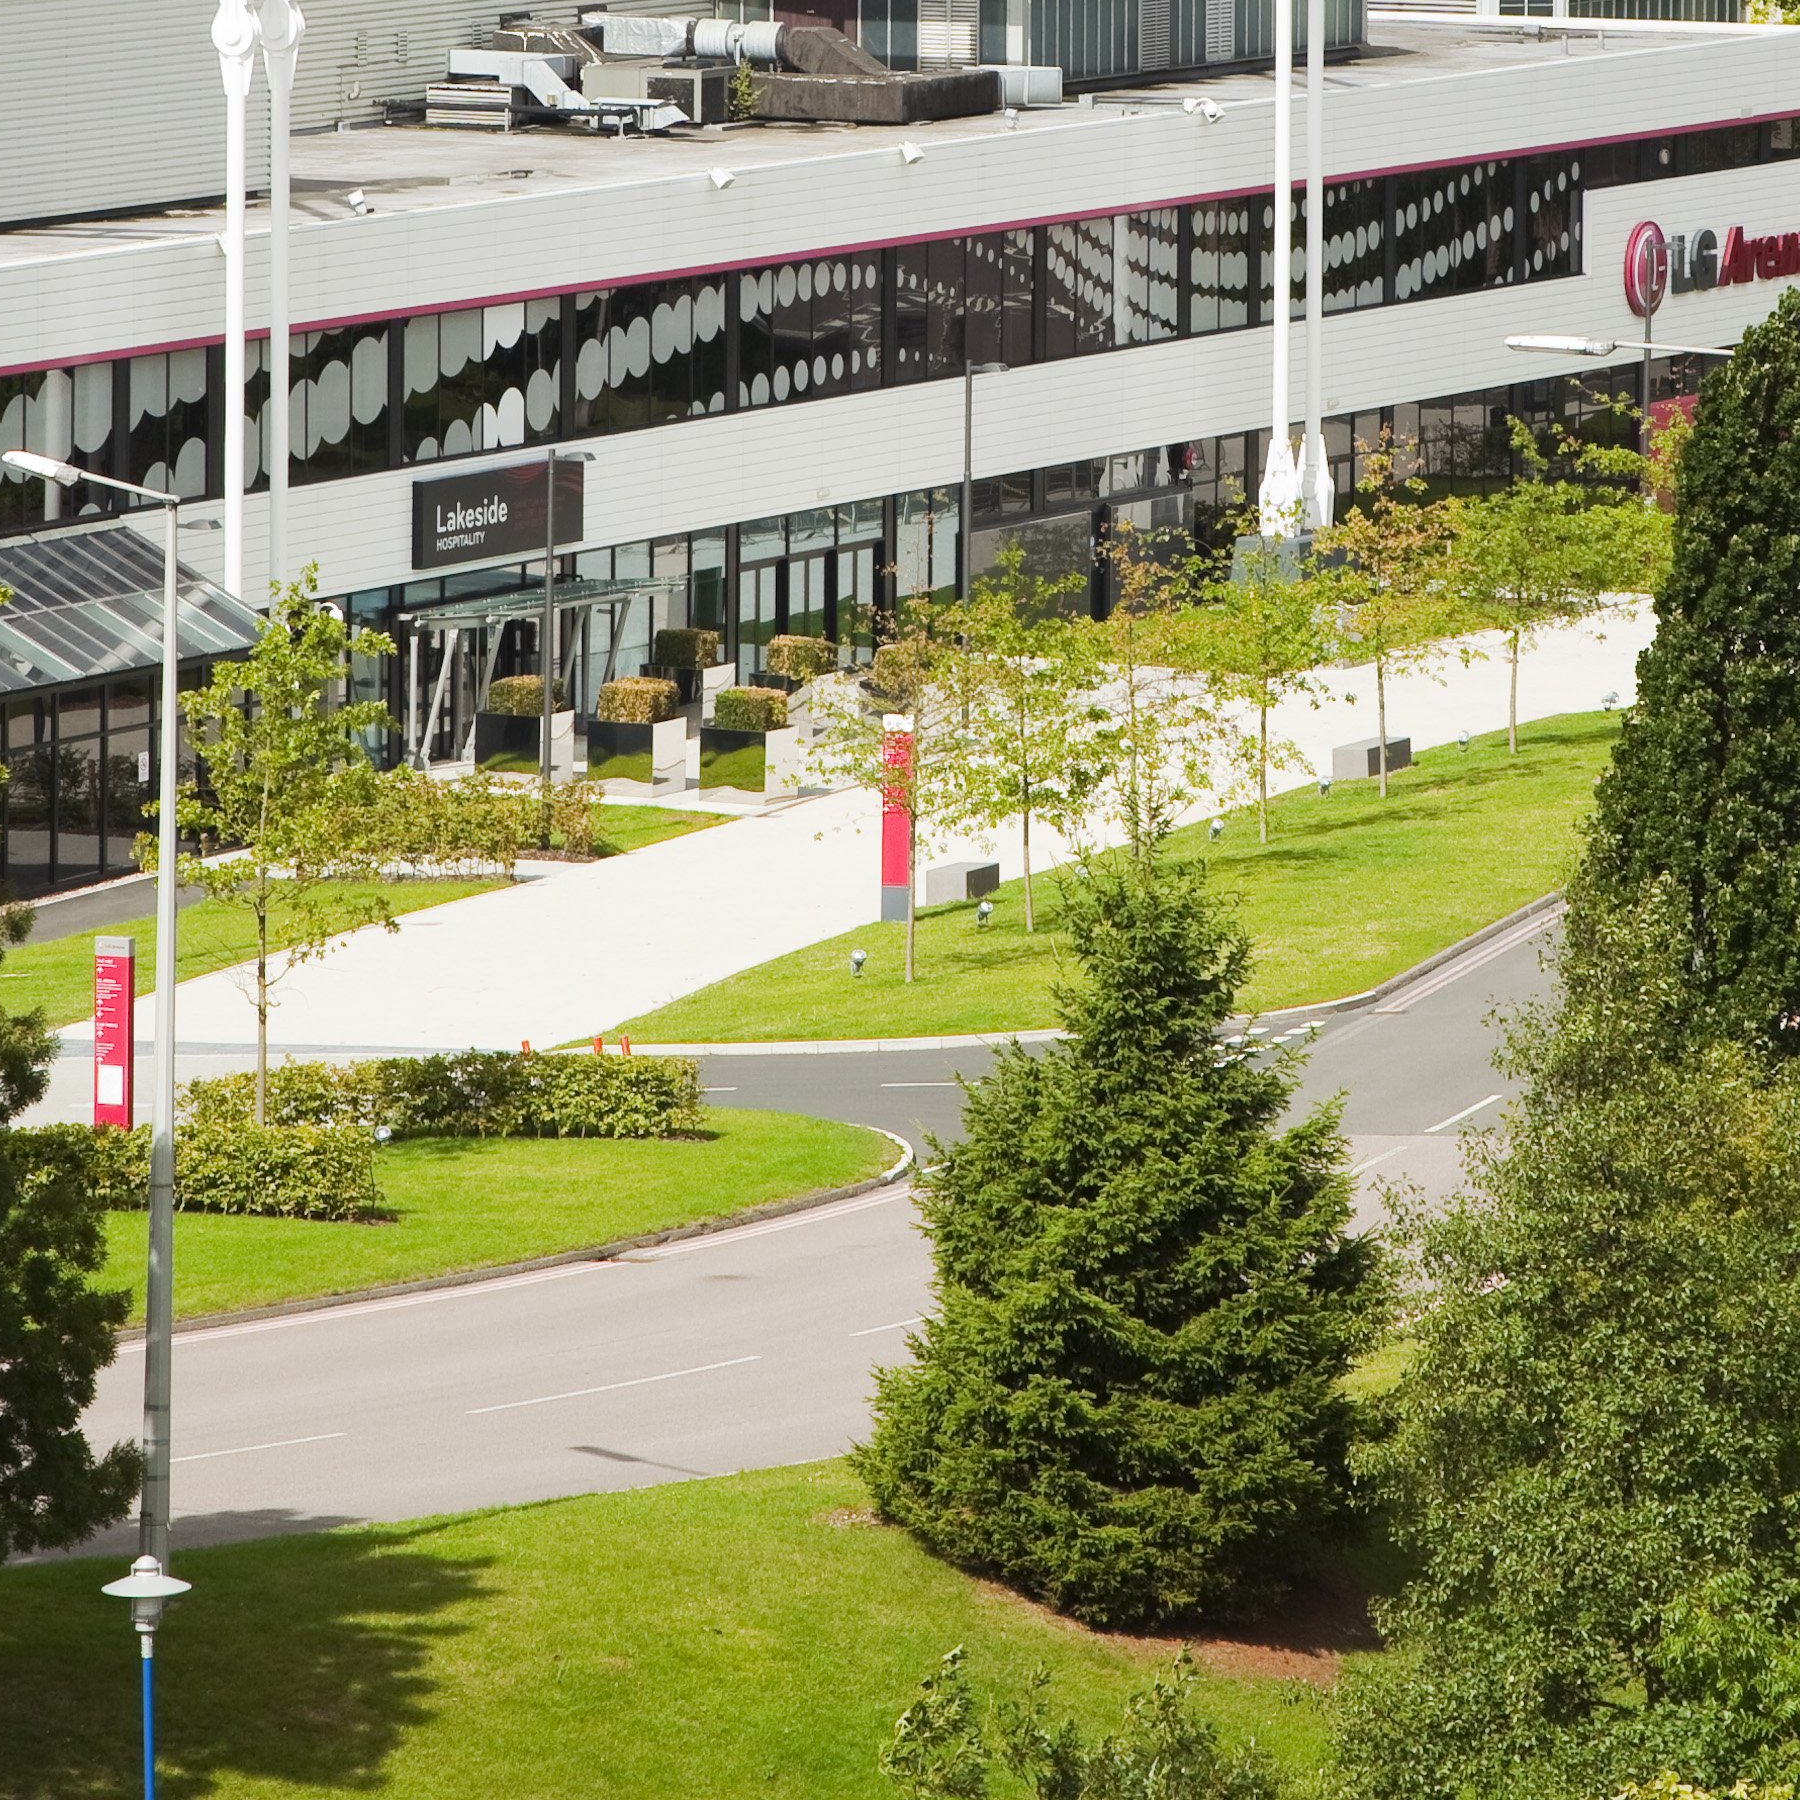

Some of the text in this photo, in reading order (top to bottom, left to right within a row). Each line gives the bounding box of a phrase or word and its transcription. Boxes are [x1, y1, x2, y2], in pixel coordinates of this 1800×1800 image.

[1671, 229, 1718, 295] LG
[436, 494, 508, 533] Lakeside
[436, 531, 486, 552] HOSPITALITY
